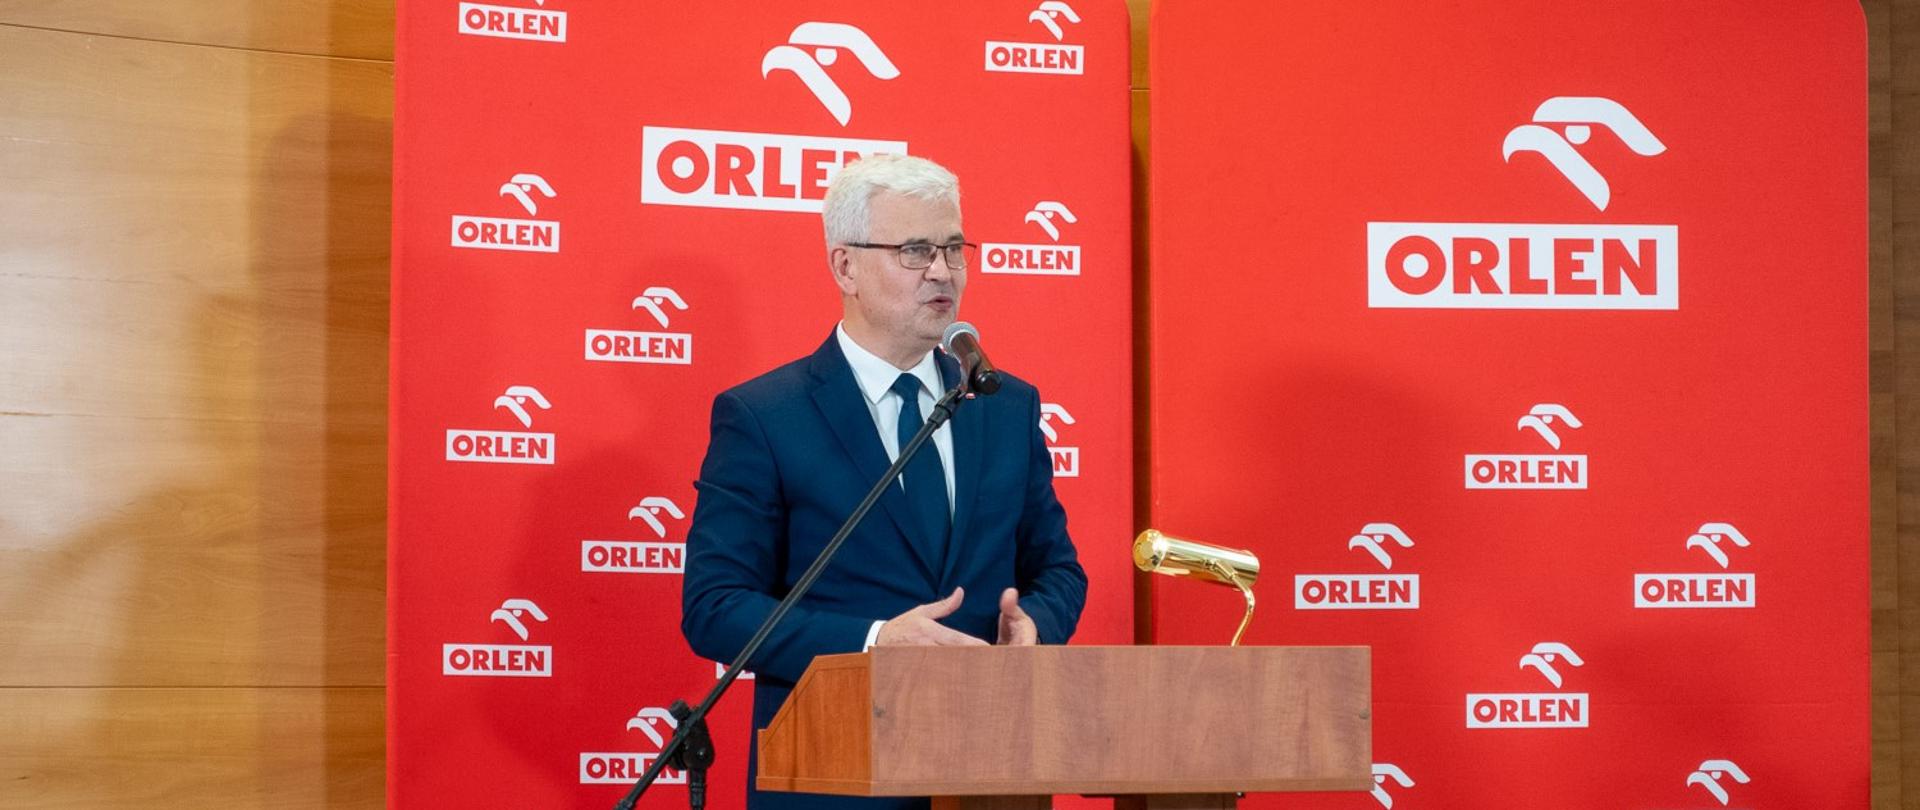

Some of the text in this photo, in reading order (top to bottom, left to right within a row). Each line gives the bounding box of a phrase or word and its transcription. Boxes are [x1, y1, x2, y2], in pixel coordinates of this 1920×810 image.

[466, 9, 559, 36] ORLEN
[992, 47, 1077, 70] ORLEN
[657, 140, 889, 200] ORLE
[458, 222, 553, 247] ORLEN
[987, 248, 1074, 270] ORLEN
[1385, 236, 1658, 296] ORLEN
[592, 335, 685, 359] ORLEN
[453, 435, 547, 459] ORLEN
[1472, 460, 1579, 484] ORLEN
[588, 546, 682, 569] ORLEN
[1302, 580, 1411, 604] ORLEN
[1642, 579, 1747, 603] ORLEN
[450, 649, 545, 672] ORLEN
[1474, 699, 1581, 723] ORLEN
